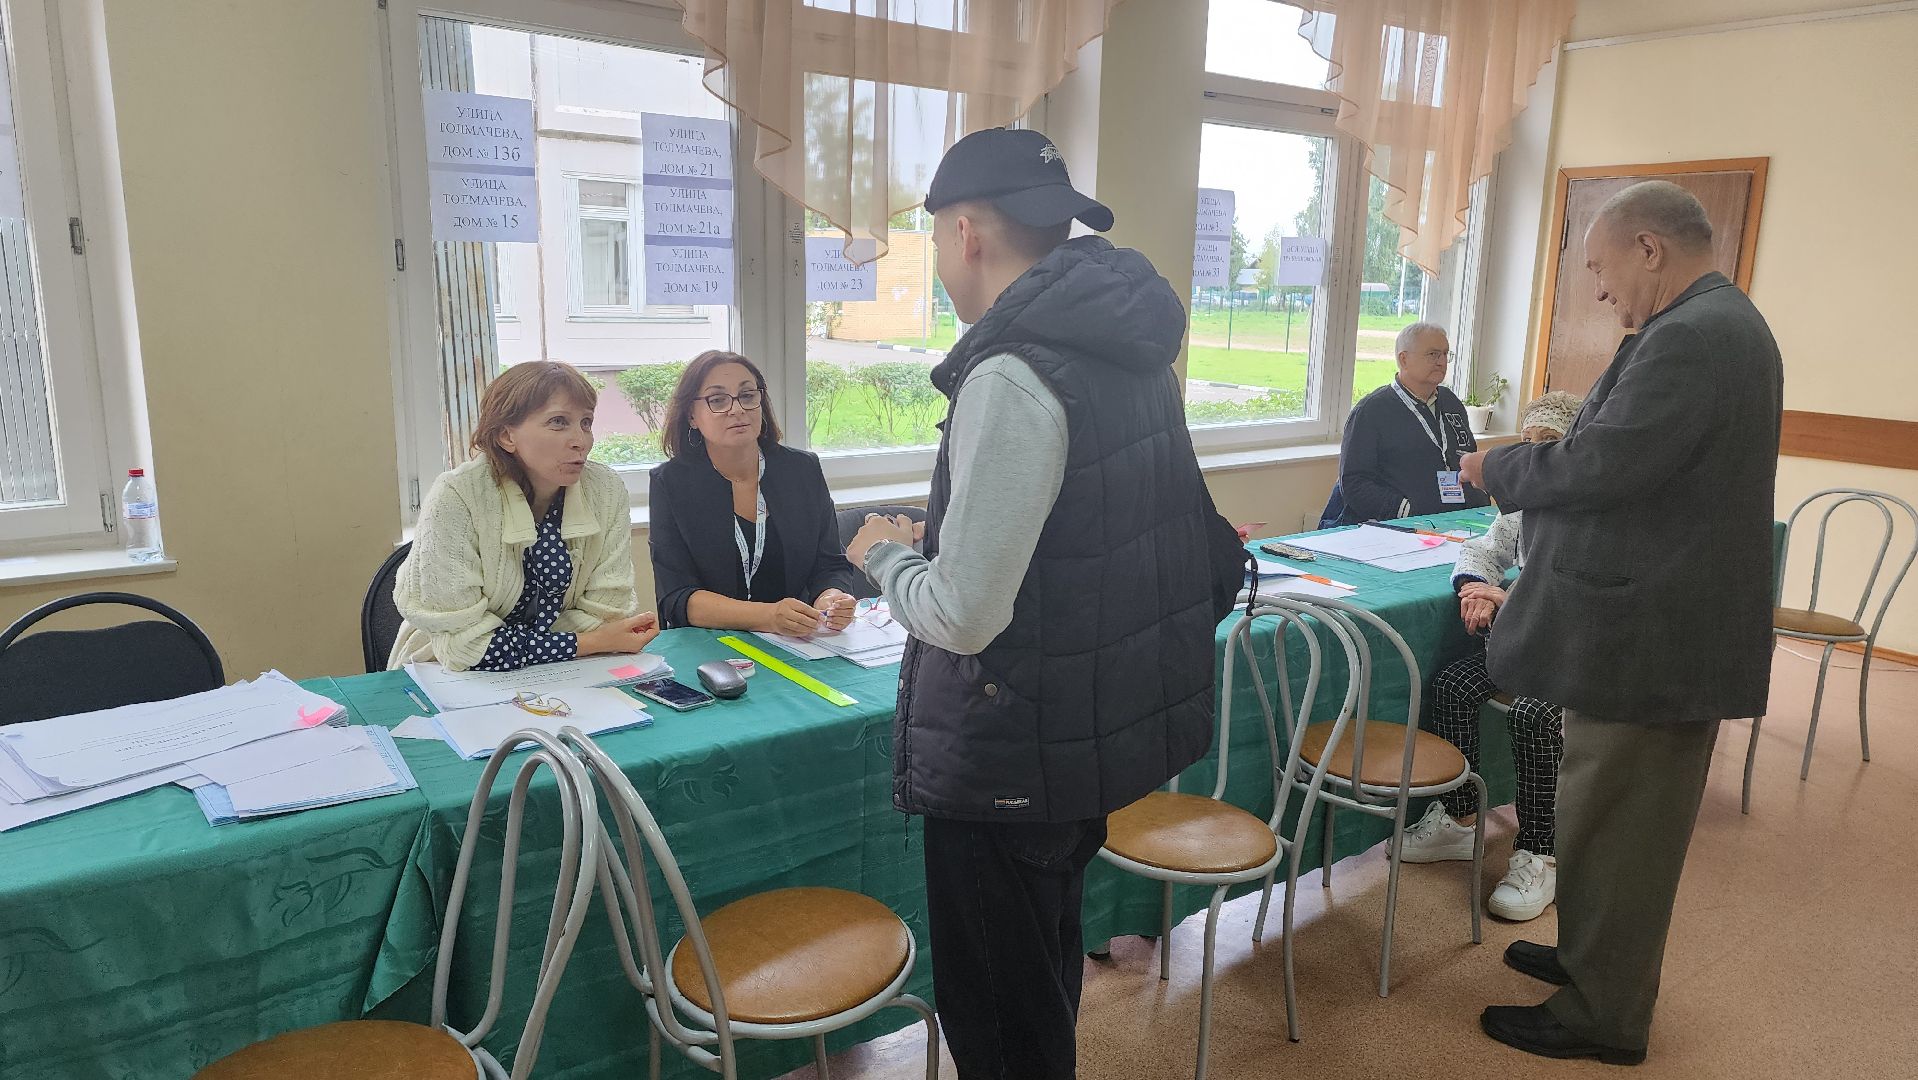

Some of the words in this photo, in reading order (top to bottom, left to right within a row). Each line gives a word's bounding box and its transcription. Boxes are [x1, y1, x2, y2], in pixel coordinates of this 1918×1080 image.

[456, 106, 503, 121] УЛИЦА
[439, 122, 523, 141] ТОЛМАЧЕВА,
[667, 128, 706, 142] УЛИЦА
[442, 145, 472, 158] ДОМ
[476, 148, 490, 160] №
[653, 141, 722, 158] ТОЛМАЧЕВА,
[660, 163, 684, 175] ДОМ
[687, 165, 698, 176] №
[700, 162, 714, 177] 21
[460, 178, 507, 192] УЛИЦА
[443, 194, 527, 208] ТОЛМАЧЕВА,
[670, 188, 707, 200] УЛИЦА
[654, 202, 723, 217] ТОЛМАЧЕВА,
[454, 216, 482, 229] ДОМ
[486, 217, 499, 228] №
[501, 214, 519, 229] 15
[658, 222, 683, 235] ДОМ
[686, 224, 697, 234] №
[699, 221, 721, 235] 21а
[672, 248, 709, 260] УЛИЦА
[663, 282, 688, 294] ДОМ
[690, 283, 701, 293] №
[705, 280, 718, 294] 19
[817, 281, 838, 291] ДОМ
[839, 281, 849, 290] №
[850, 278, 863, 291] 23
